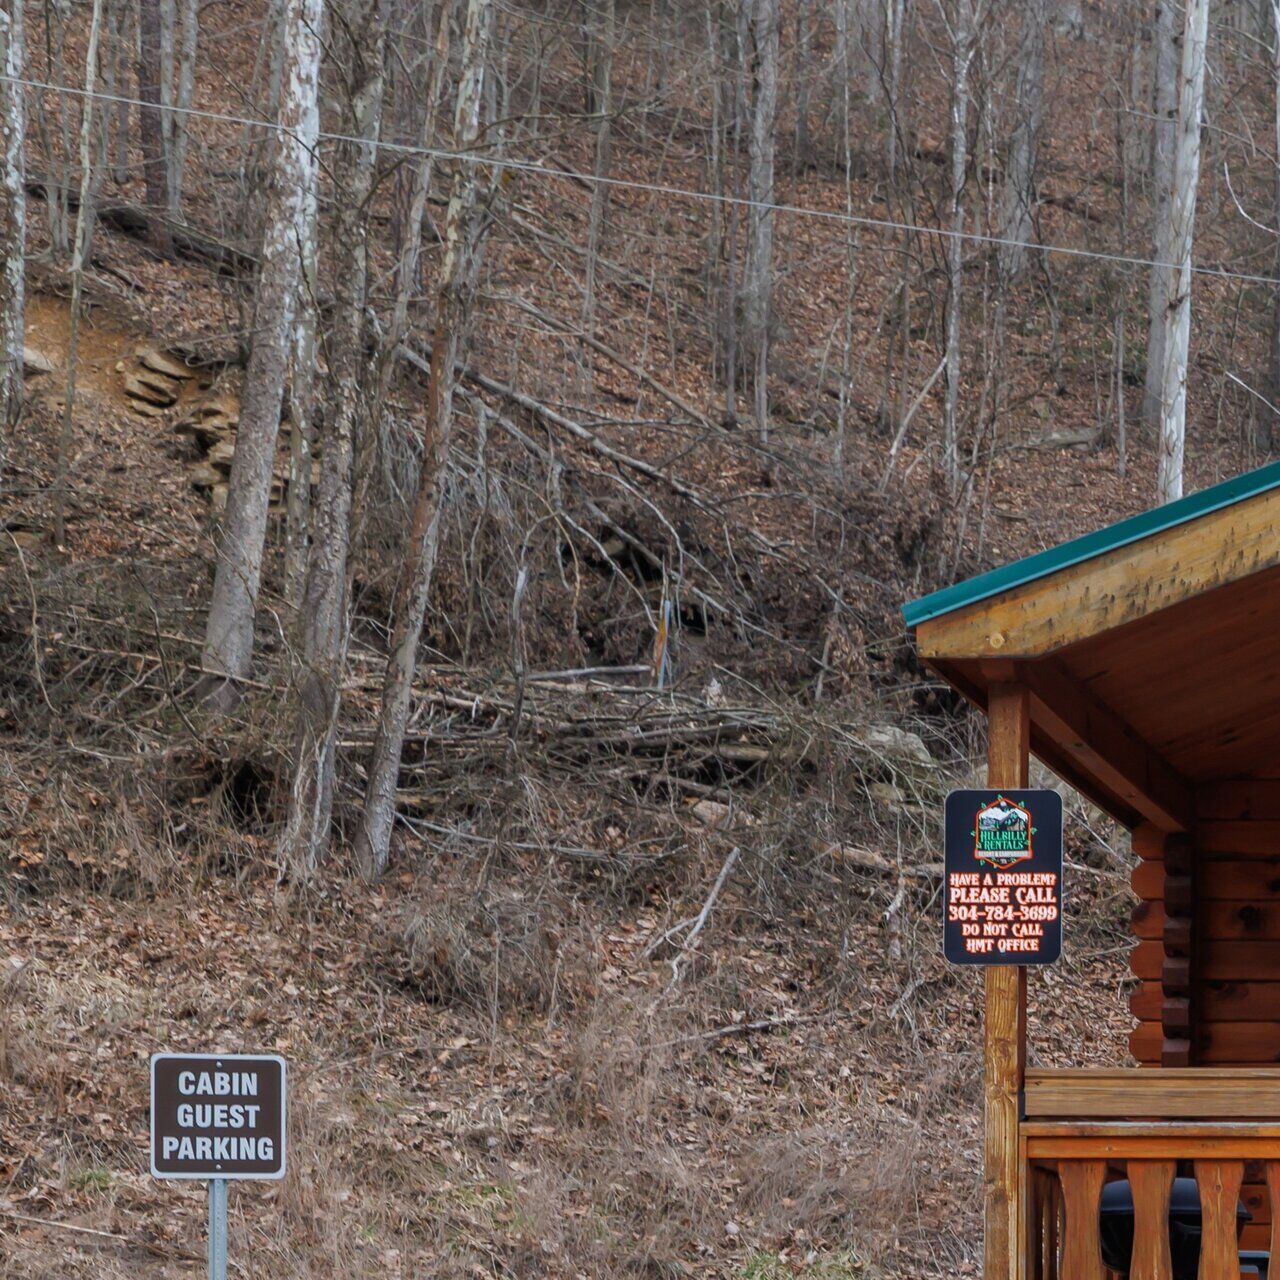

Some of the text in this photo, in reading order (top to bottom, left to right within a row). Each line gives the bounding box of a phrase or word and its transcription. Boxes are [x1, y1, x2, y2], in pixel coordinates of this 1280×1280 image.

[981, 831, 1027, 842] HILLBILLY
[984, 840, 1023, 850] RENTALS
[950, 873, 1057, 887] HAVE A PROBLEM?
[950, 887, 1057, 905] PLEASE CALL
[949, 905, 1058, 921] 304-784-3699
[962, 922, 1043, 938] DO NOT CALL
[966, 938, 1039, 953] HMT OFFICE
[178, 1071, 258, 1096] CABIN
[177, 1103, 260, 1128] GUEST
[162, 1136, 274, 1160] PARKING
